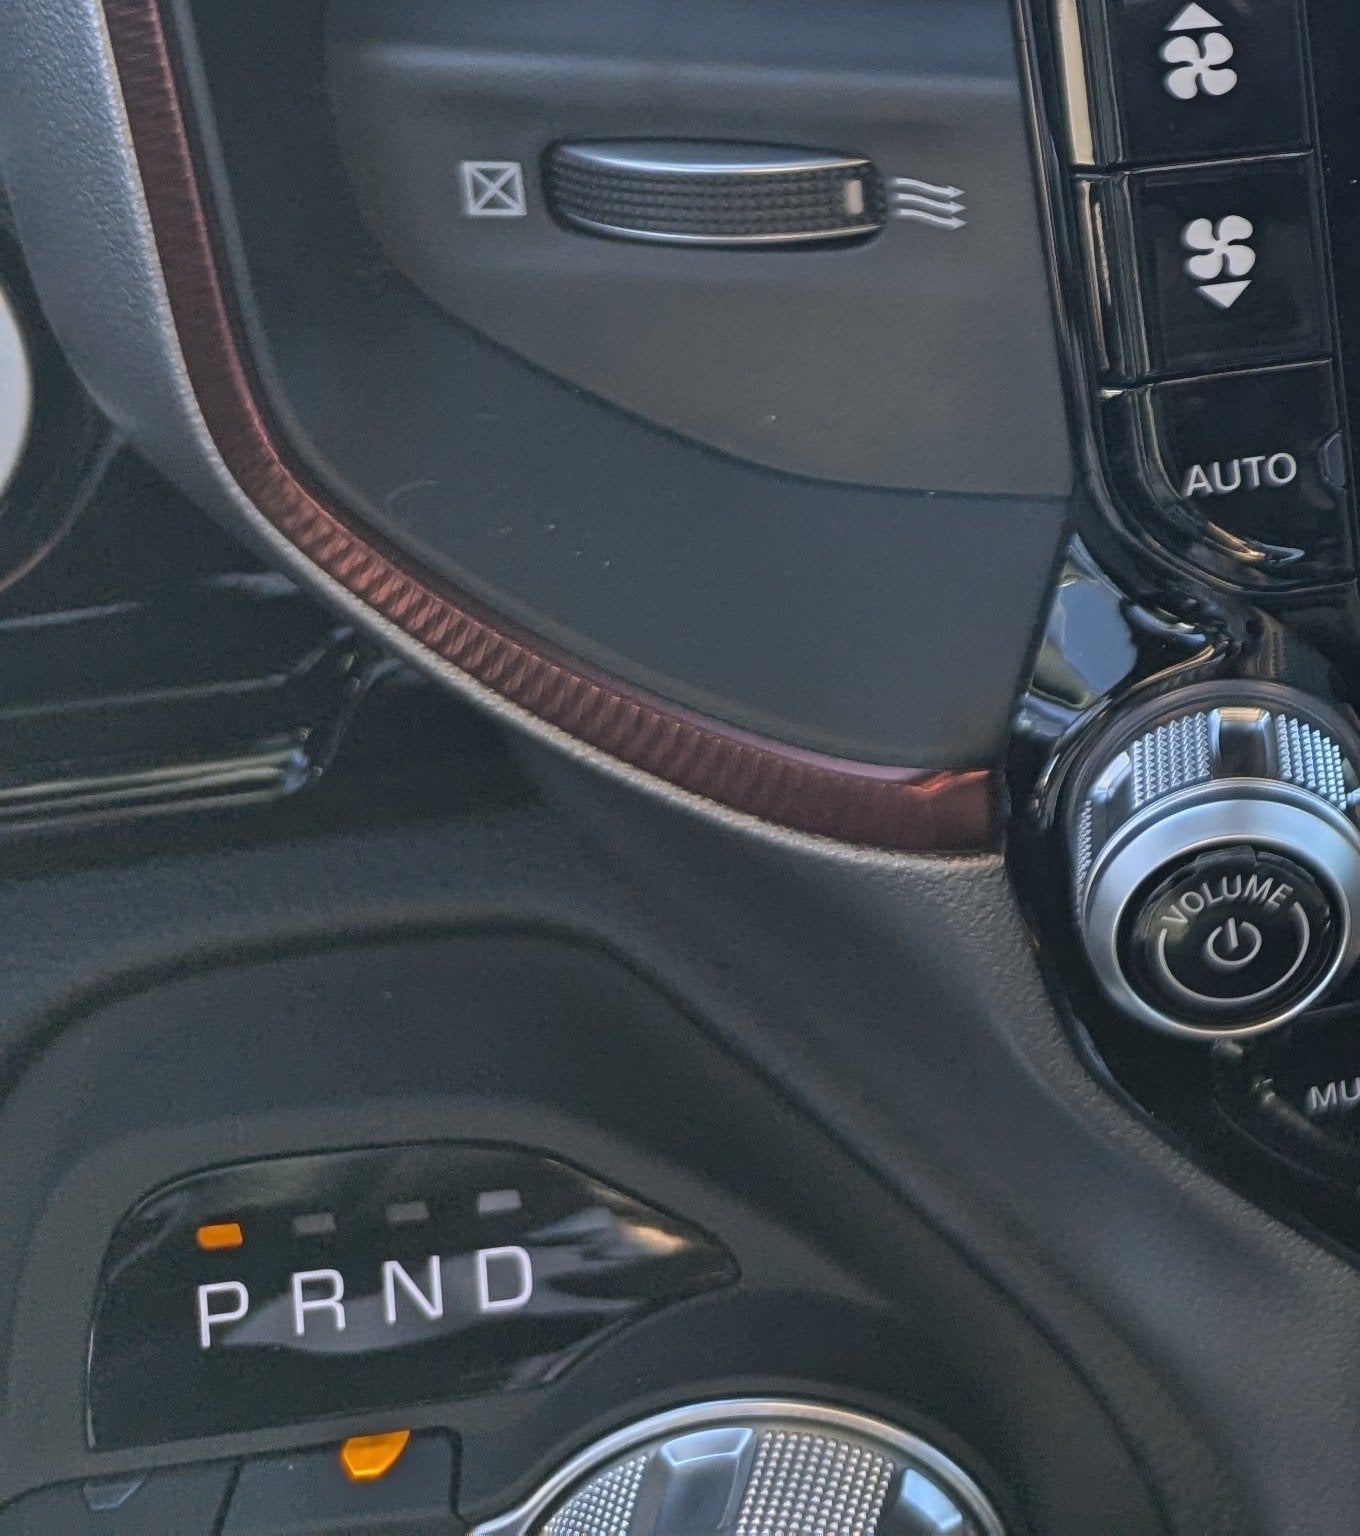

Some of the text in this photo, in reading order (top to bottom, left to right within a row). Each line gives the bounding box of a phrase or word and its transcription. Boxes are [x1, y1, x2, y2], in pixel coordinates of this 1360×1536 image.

[1184, 451, 1299, 500] AUTO
[1160, 873, 1294, 929] VOLUME
[199, 1244, 533, 1348] P R N D
